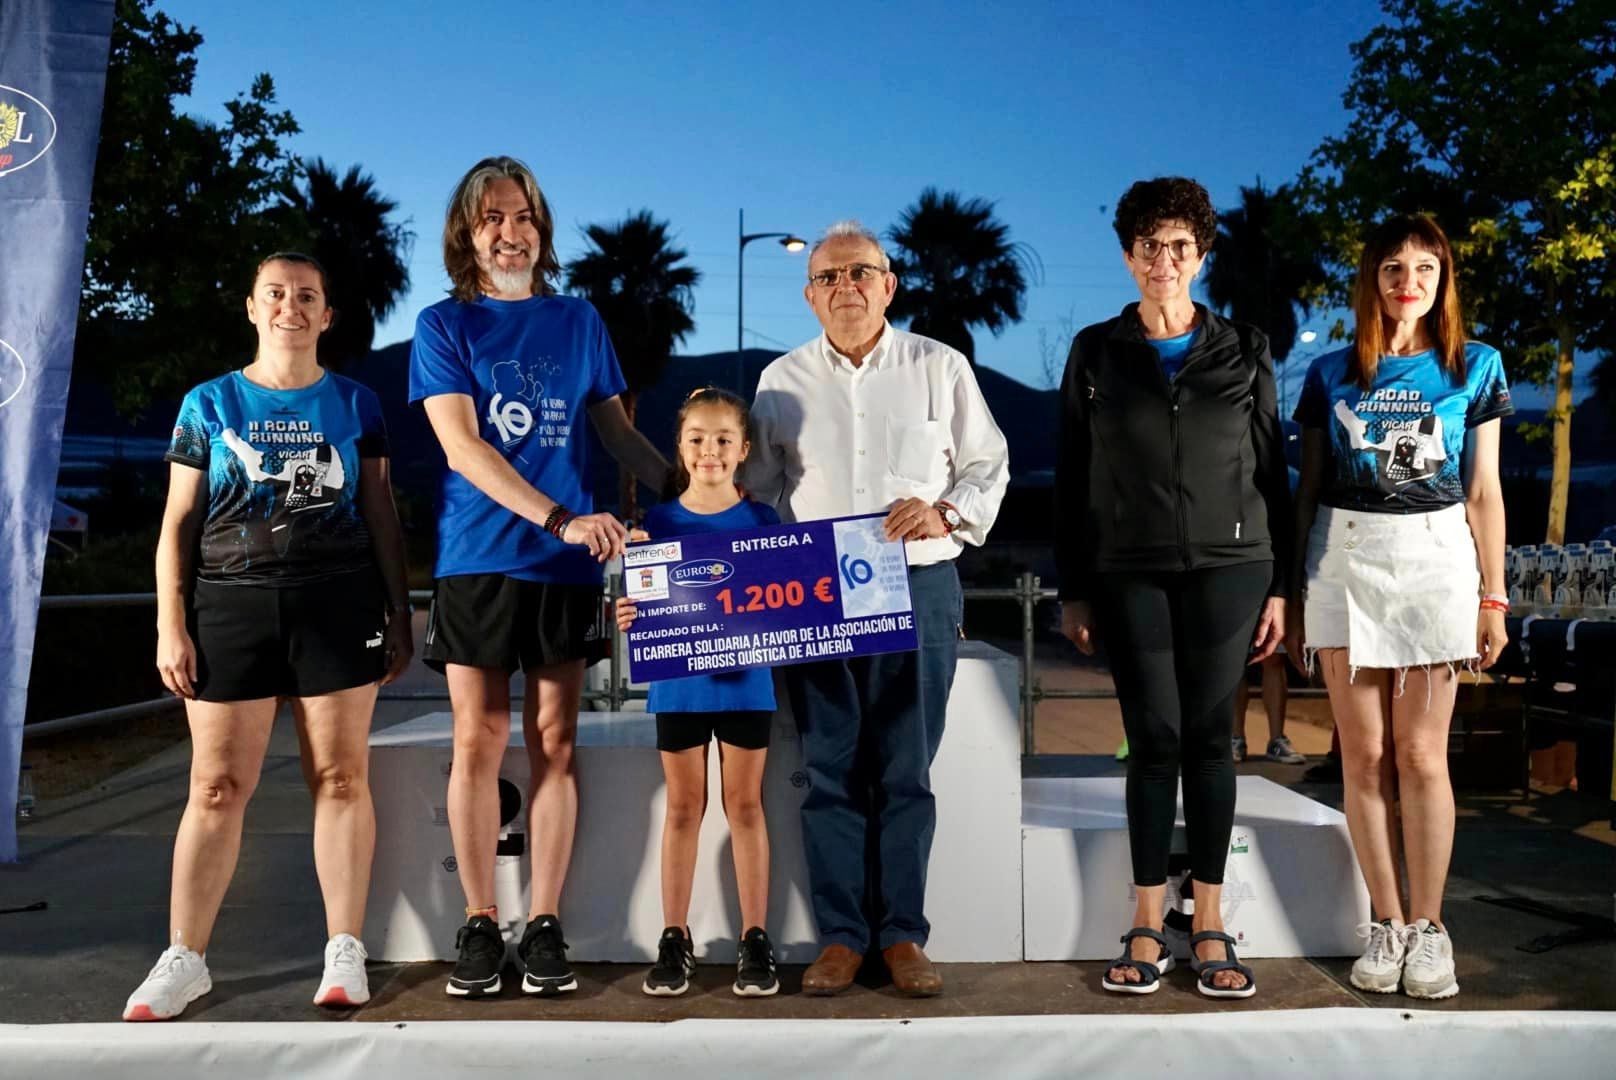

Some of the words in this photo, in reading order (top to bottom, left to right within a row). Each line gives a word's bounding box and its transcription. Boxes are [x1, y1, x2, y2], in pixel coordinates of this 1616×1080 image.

[1375, 388, 1420, 401] ROAD
[1355, 401, 1432, 413] RUNNING
[249, 421, 259, 431] II
[264, 421, 310, 431] ROAD
[249, 432, 324, 443] RUNNING
[731, 534, 799, 553] ENTREGA
[802, 533, 813, 545] A
[716, 580, 805, 615] 1.200
[813, 576, 834, 603] €
[648, 604, 689, 617] IMPORTE
[691, 602, 707, 611] DE:
[630, 626, 689, 641] RECAUDADO
[691, 624, 704, 634] EN
[706, 623, 719, 632] LA
[633, 647, 641, 662] II
[643, 642, 693, 661] CARRERA
[694, 634, 751, 656] SOLIDARIA
[752, 634, 761, 649] A
[762, 629, 798, 647] FAVOR
[800, 626, 815, 642] DE
[816, 625, 832, 640] LA
[833, 616, 897, 638] ASOCIACIÓN
[898, 615, 913, 630] DE
[688, 654, 736, 672] FIBROSIS
[738, 645, 787, 666] QUÍSTICA
[789, 644, 803, 660] DE
[805, 635, 854, 658] ALMERÍA
